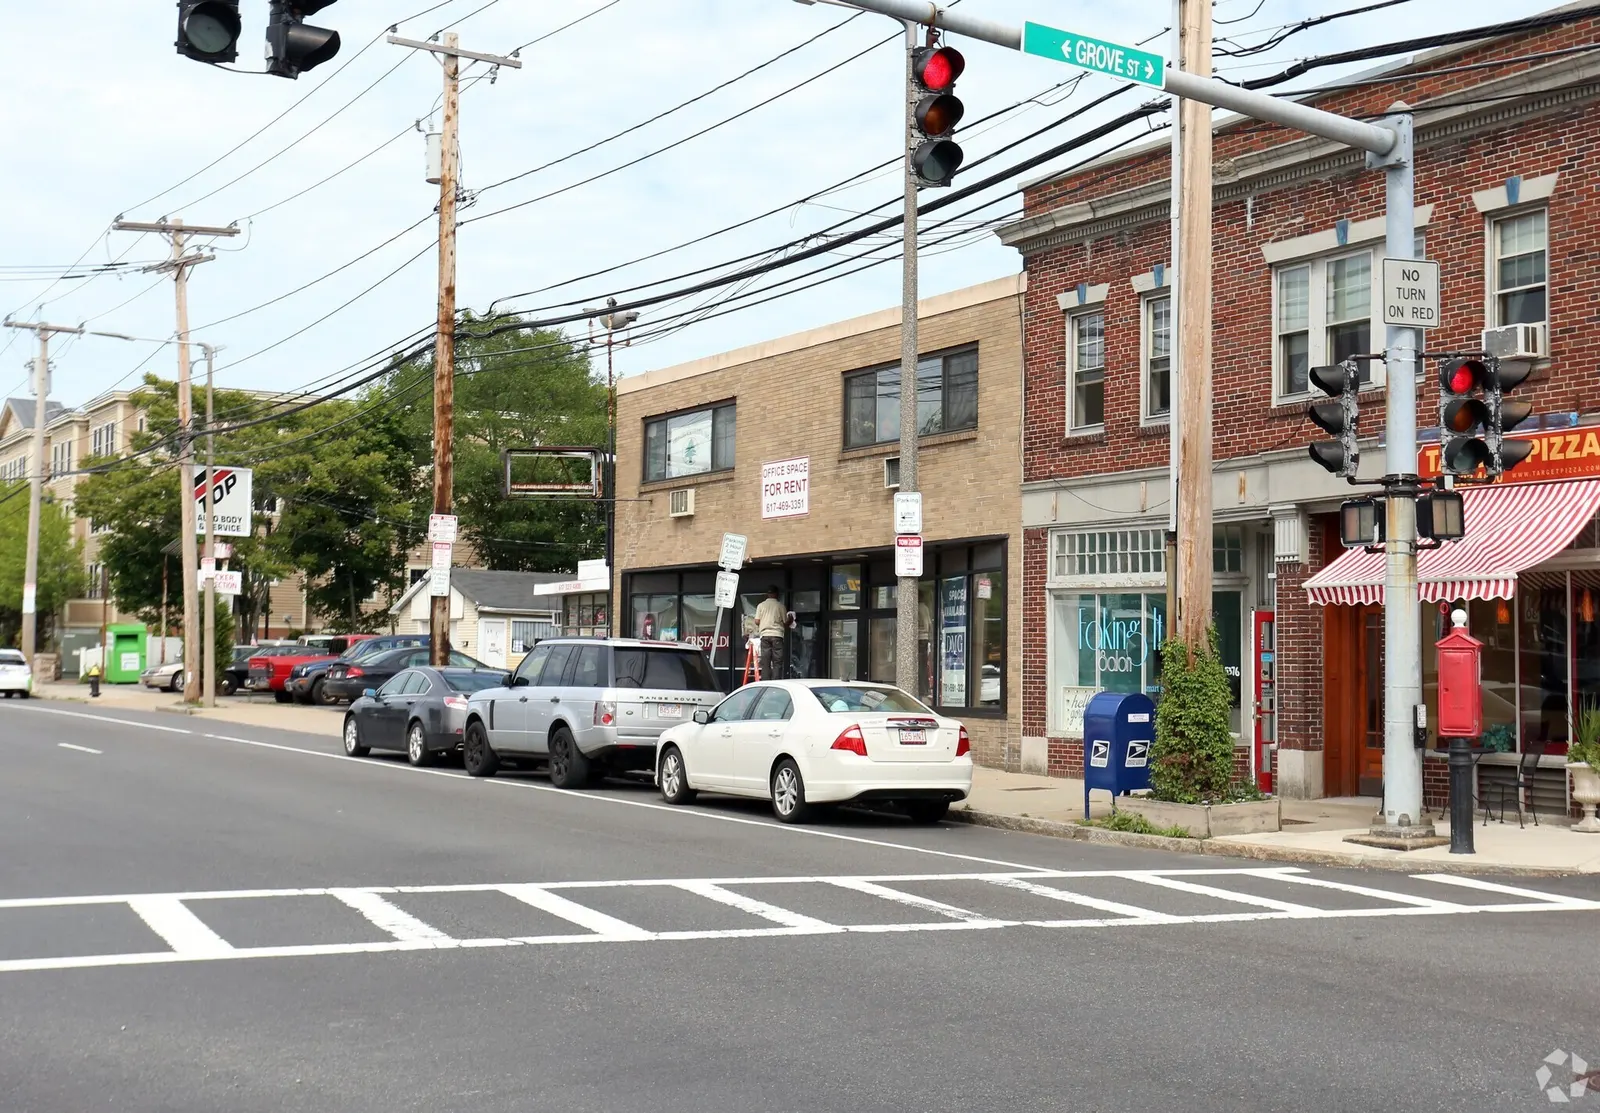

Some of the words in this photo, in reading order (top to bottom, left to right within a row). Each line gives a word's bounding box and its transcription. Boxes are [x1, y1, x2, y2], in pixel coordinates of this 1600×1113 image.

[1076, 40, 1124, 73] GROVE
[1127, 58, 1140, 77] ST
[1402, 269, 1420, 281] NO
[1396, 287, 1426, 300] TURN
[1388, 305, 1404, 317] ON
[1412, 307, 1434, 319] RED
[1525, 432, 1600, 463] PIZZA
[763, 465, 785, 478] OFFICE
[786, 462, 808, 474] SPACE
[1512, 464, 1600, 478] WWW.TARGETPIZZA.COM
[765, 482, 782, 497] FOR
[784, 478, 807, 494] RENT
[766, 499, 804, 513] 617-469-3351
[220, 515, 243, 523] BODY
[212, 523, 242, 532] ERVICE
[946, 634, 963, 653] DMG
[1098, 650, 1132, 672] Salon
[901, 732, 912, 741] 165
